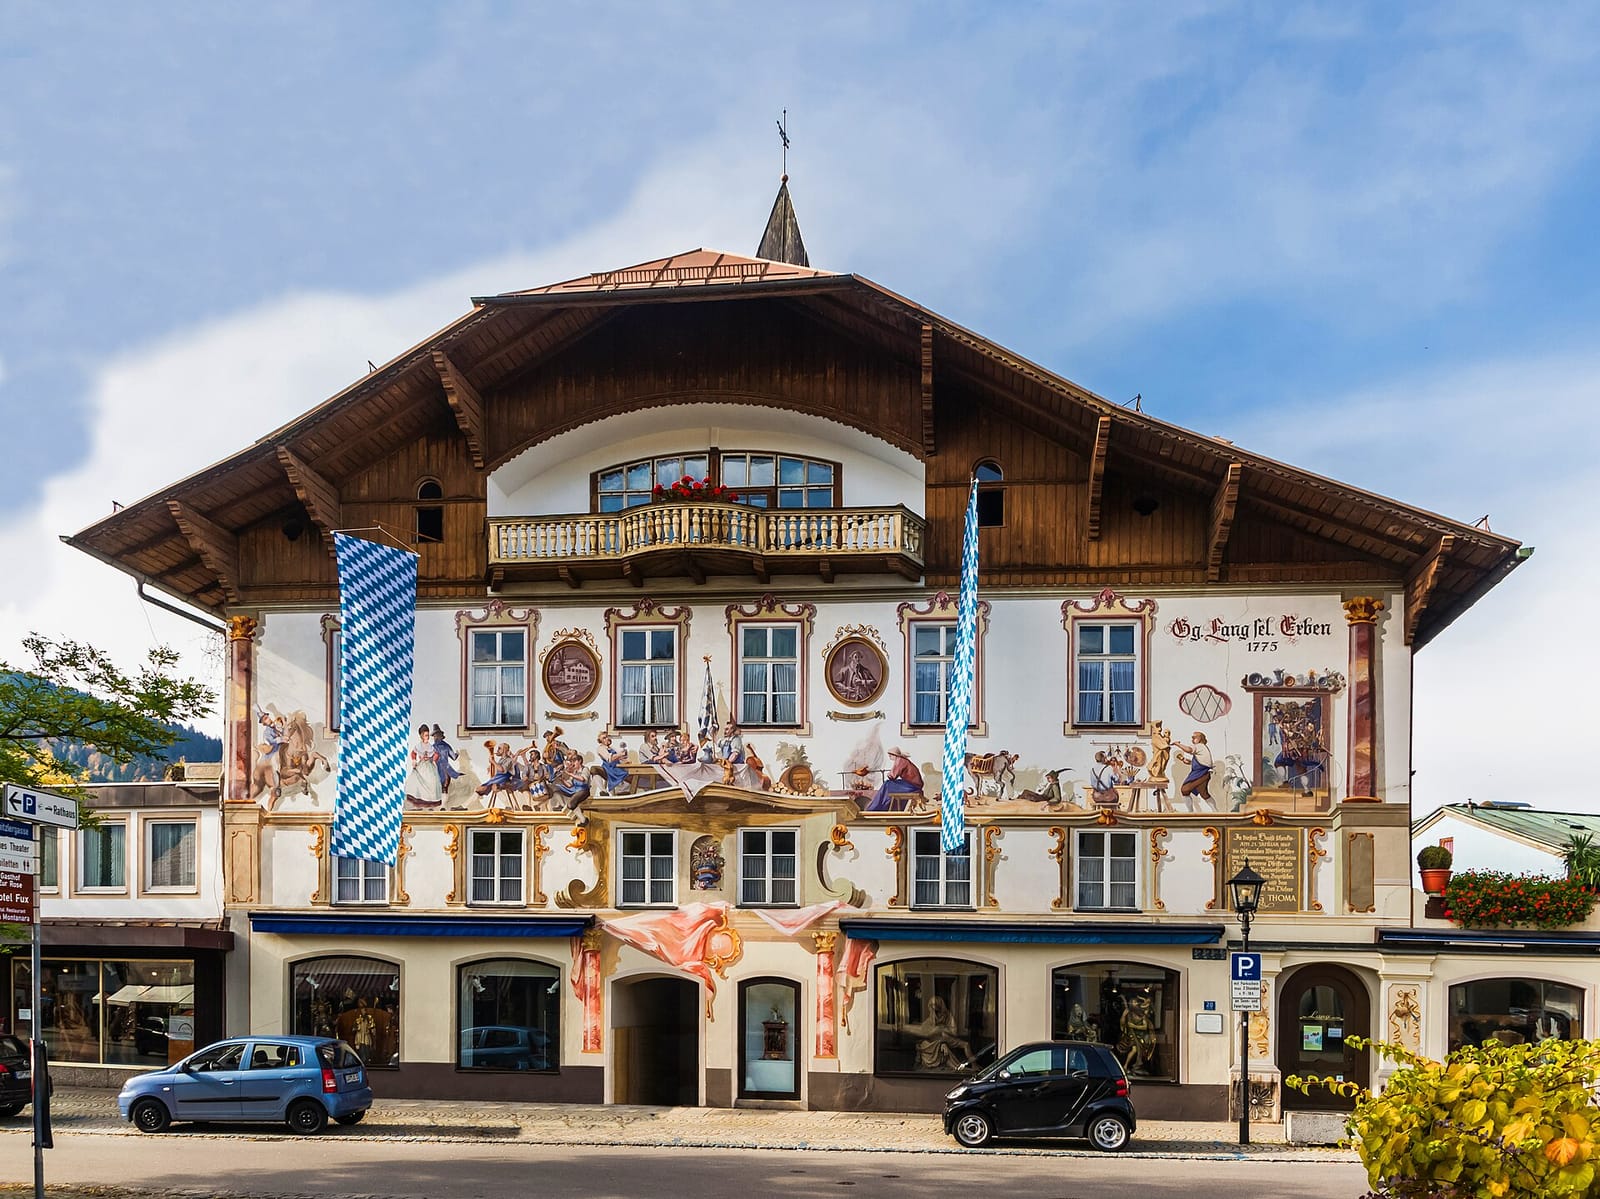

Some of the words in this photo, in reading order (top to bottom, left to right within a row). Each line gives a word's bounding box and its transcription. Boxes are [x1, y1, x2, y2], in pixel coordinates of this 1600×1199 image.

[1204, 616, 1249, 643] Lang
[1279, 614, 1332, 638] Erben
[1247, 641, 1279, 652] 1775
[25, 797, 33, 811] P
[53, 804, 75, 819] Rathaus
[9, 842, 30, 853] Theater
[0, 872, 20, 881] Gasthof
[9, 881, 23, 889] Rose
[15, 893, 29, 904] Fux
[1267, 894, 1297, 902] THOMA
[2, 913, 30, 922] Montanara
[1238, 956, 1254, 977] P
